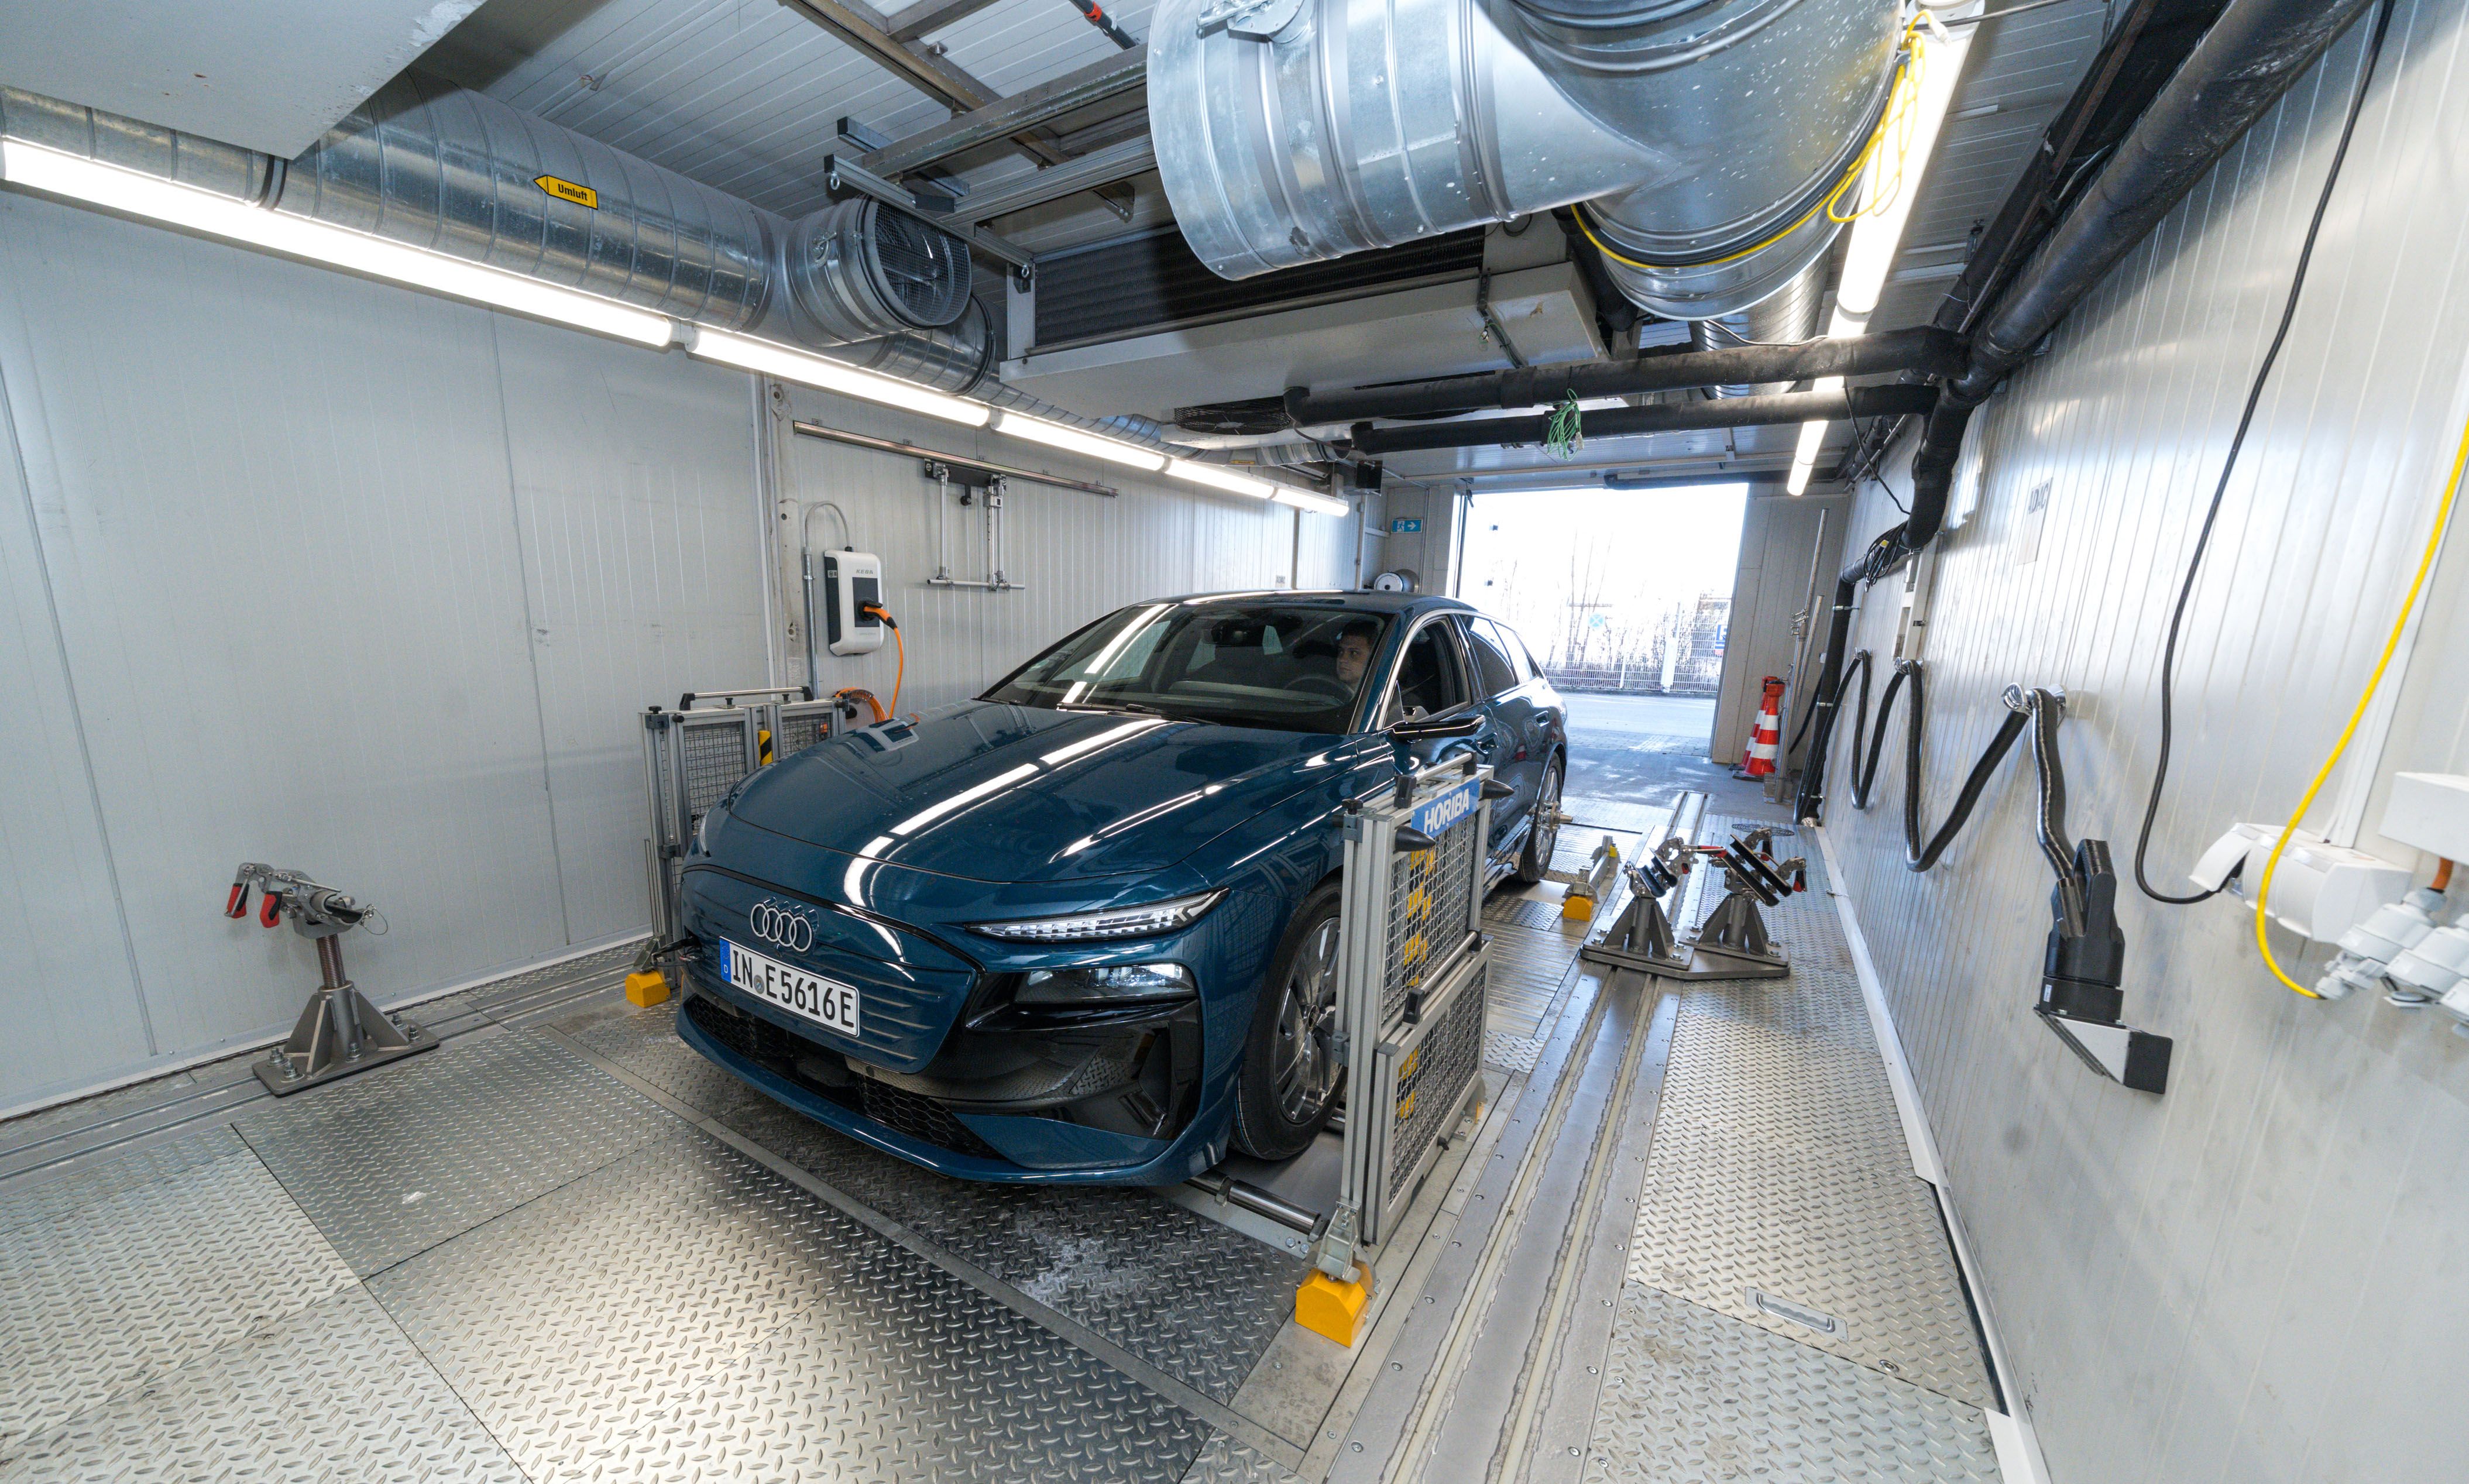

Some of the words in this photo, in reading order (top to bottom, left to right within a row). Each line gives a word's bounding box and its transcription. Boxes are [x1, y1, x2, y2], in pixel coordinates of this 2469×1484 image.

[558, 183, 588, 201] Umluft
[2027, 482, 2049, 515] ADAC
[1423, 788, 1469, 834] HORIBA
[723, 964, 729, 974] D
